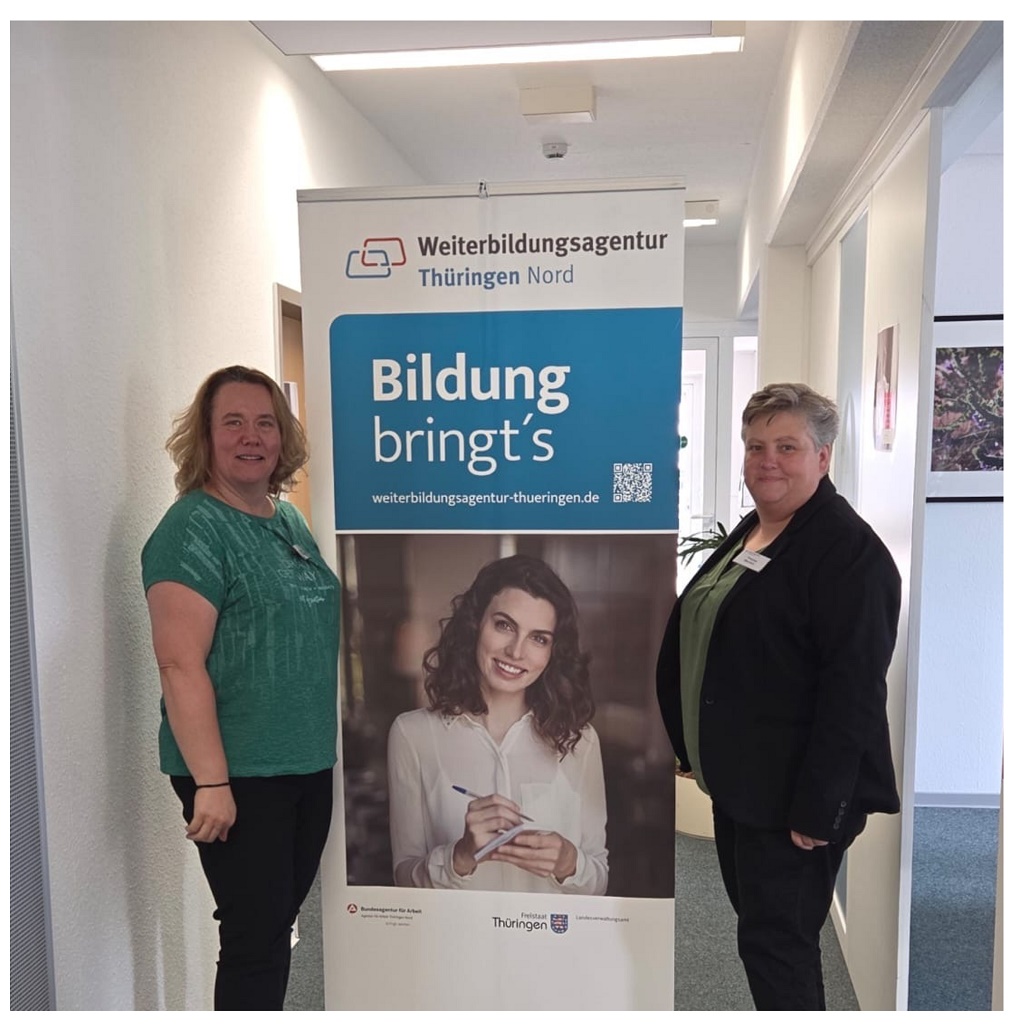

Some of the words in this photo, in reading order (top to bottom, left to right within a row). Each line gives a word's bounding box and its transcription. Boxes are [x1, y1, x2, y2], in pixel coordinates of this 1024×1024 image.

[418, 231, 668, 257] Weiterbildungsagentur
[418, 267, 520, 290] Thüringen
[527, 265, 574, 285] Nord
[372, 352, 571, 415] Bildung
[372, 490, 599, 507] weiterbildungsagentur-thueringen.de
[492, 917, 548, 932] Thüringen
[521, 912, 547, 920] Freistaat
